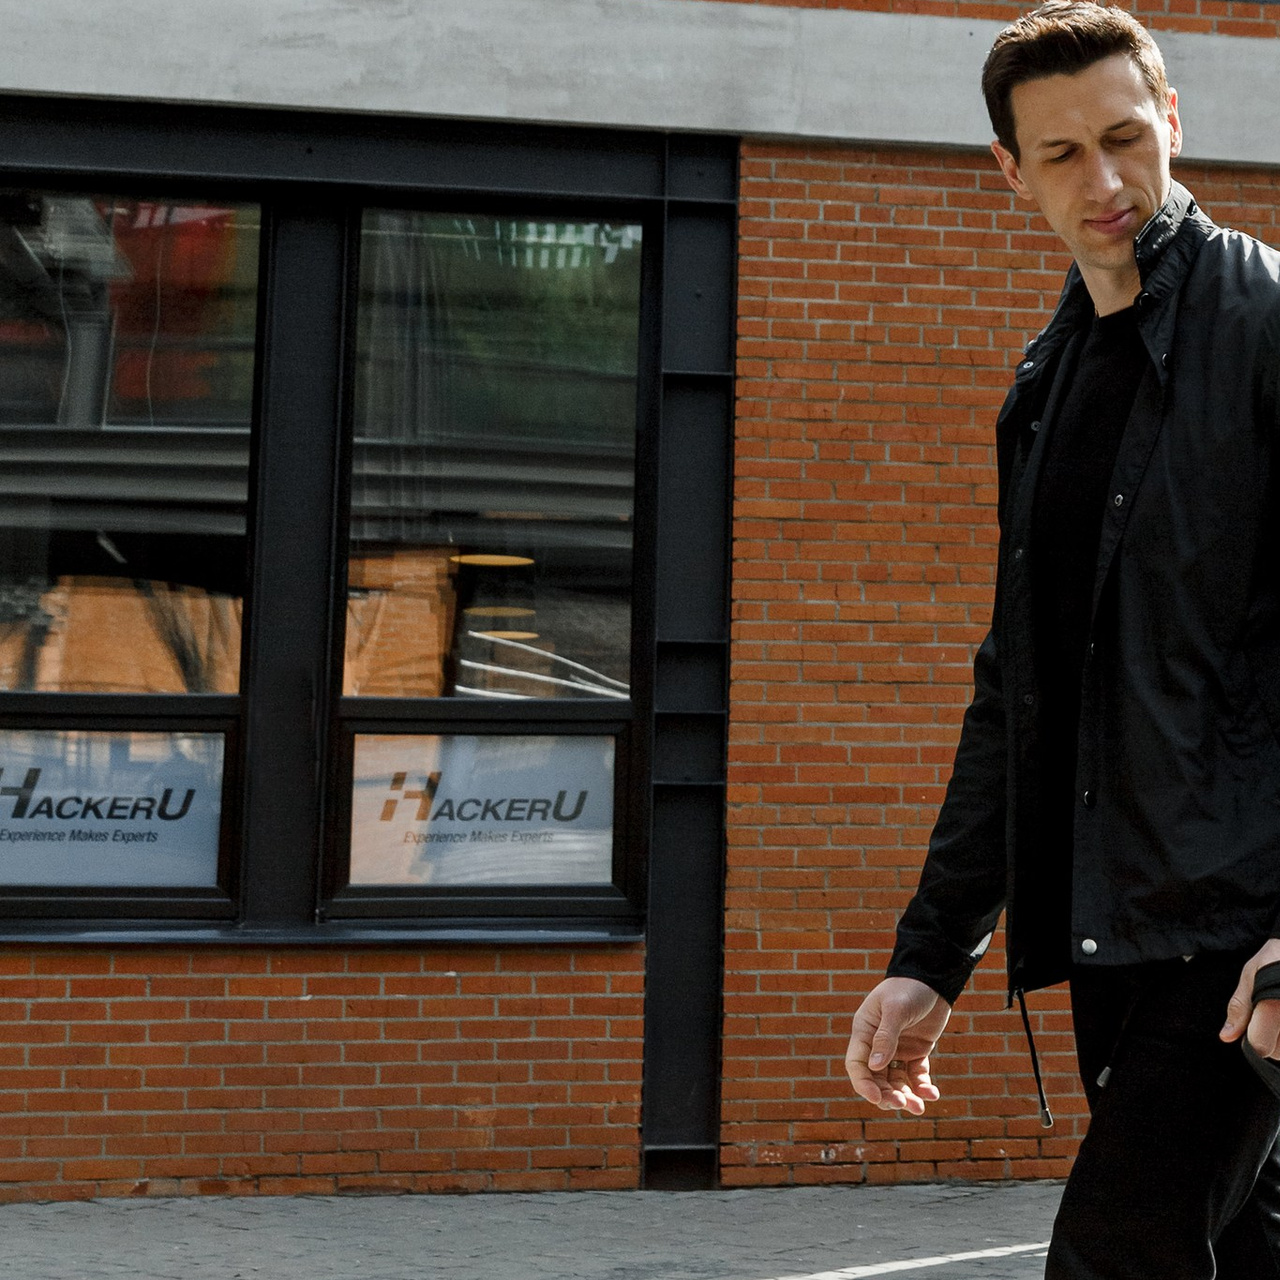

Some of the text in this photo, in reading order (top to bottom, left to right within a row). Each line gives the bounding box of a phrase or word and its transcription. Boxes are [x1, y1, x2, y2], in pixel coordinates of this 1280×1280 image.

[0, 828, 158, 844] Experience Makes Experts
[403, 830, 554, 845] Experience Makes Experts
